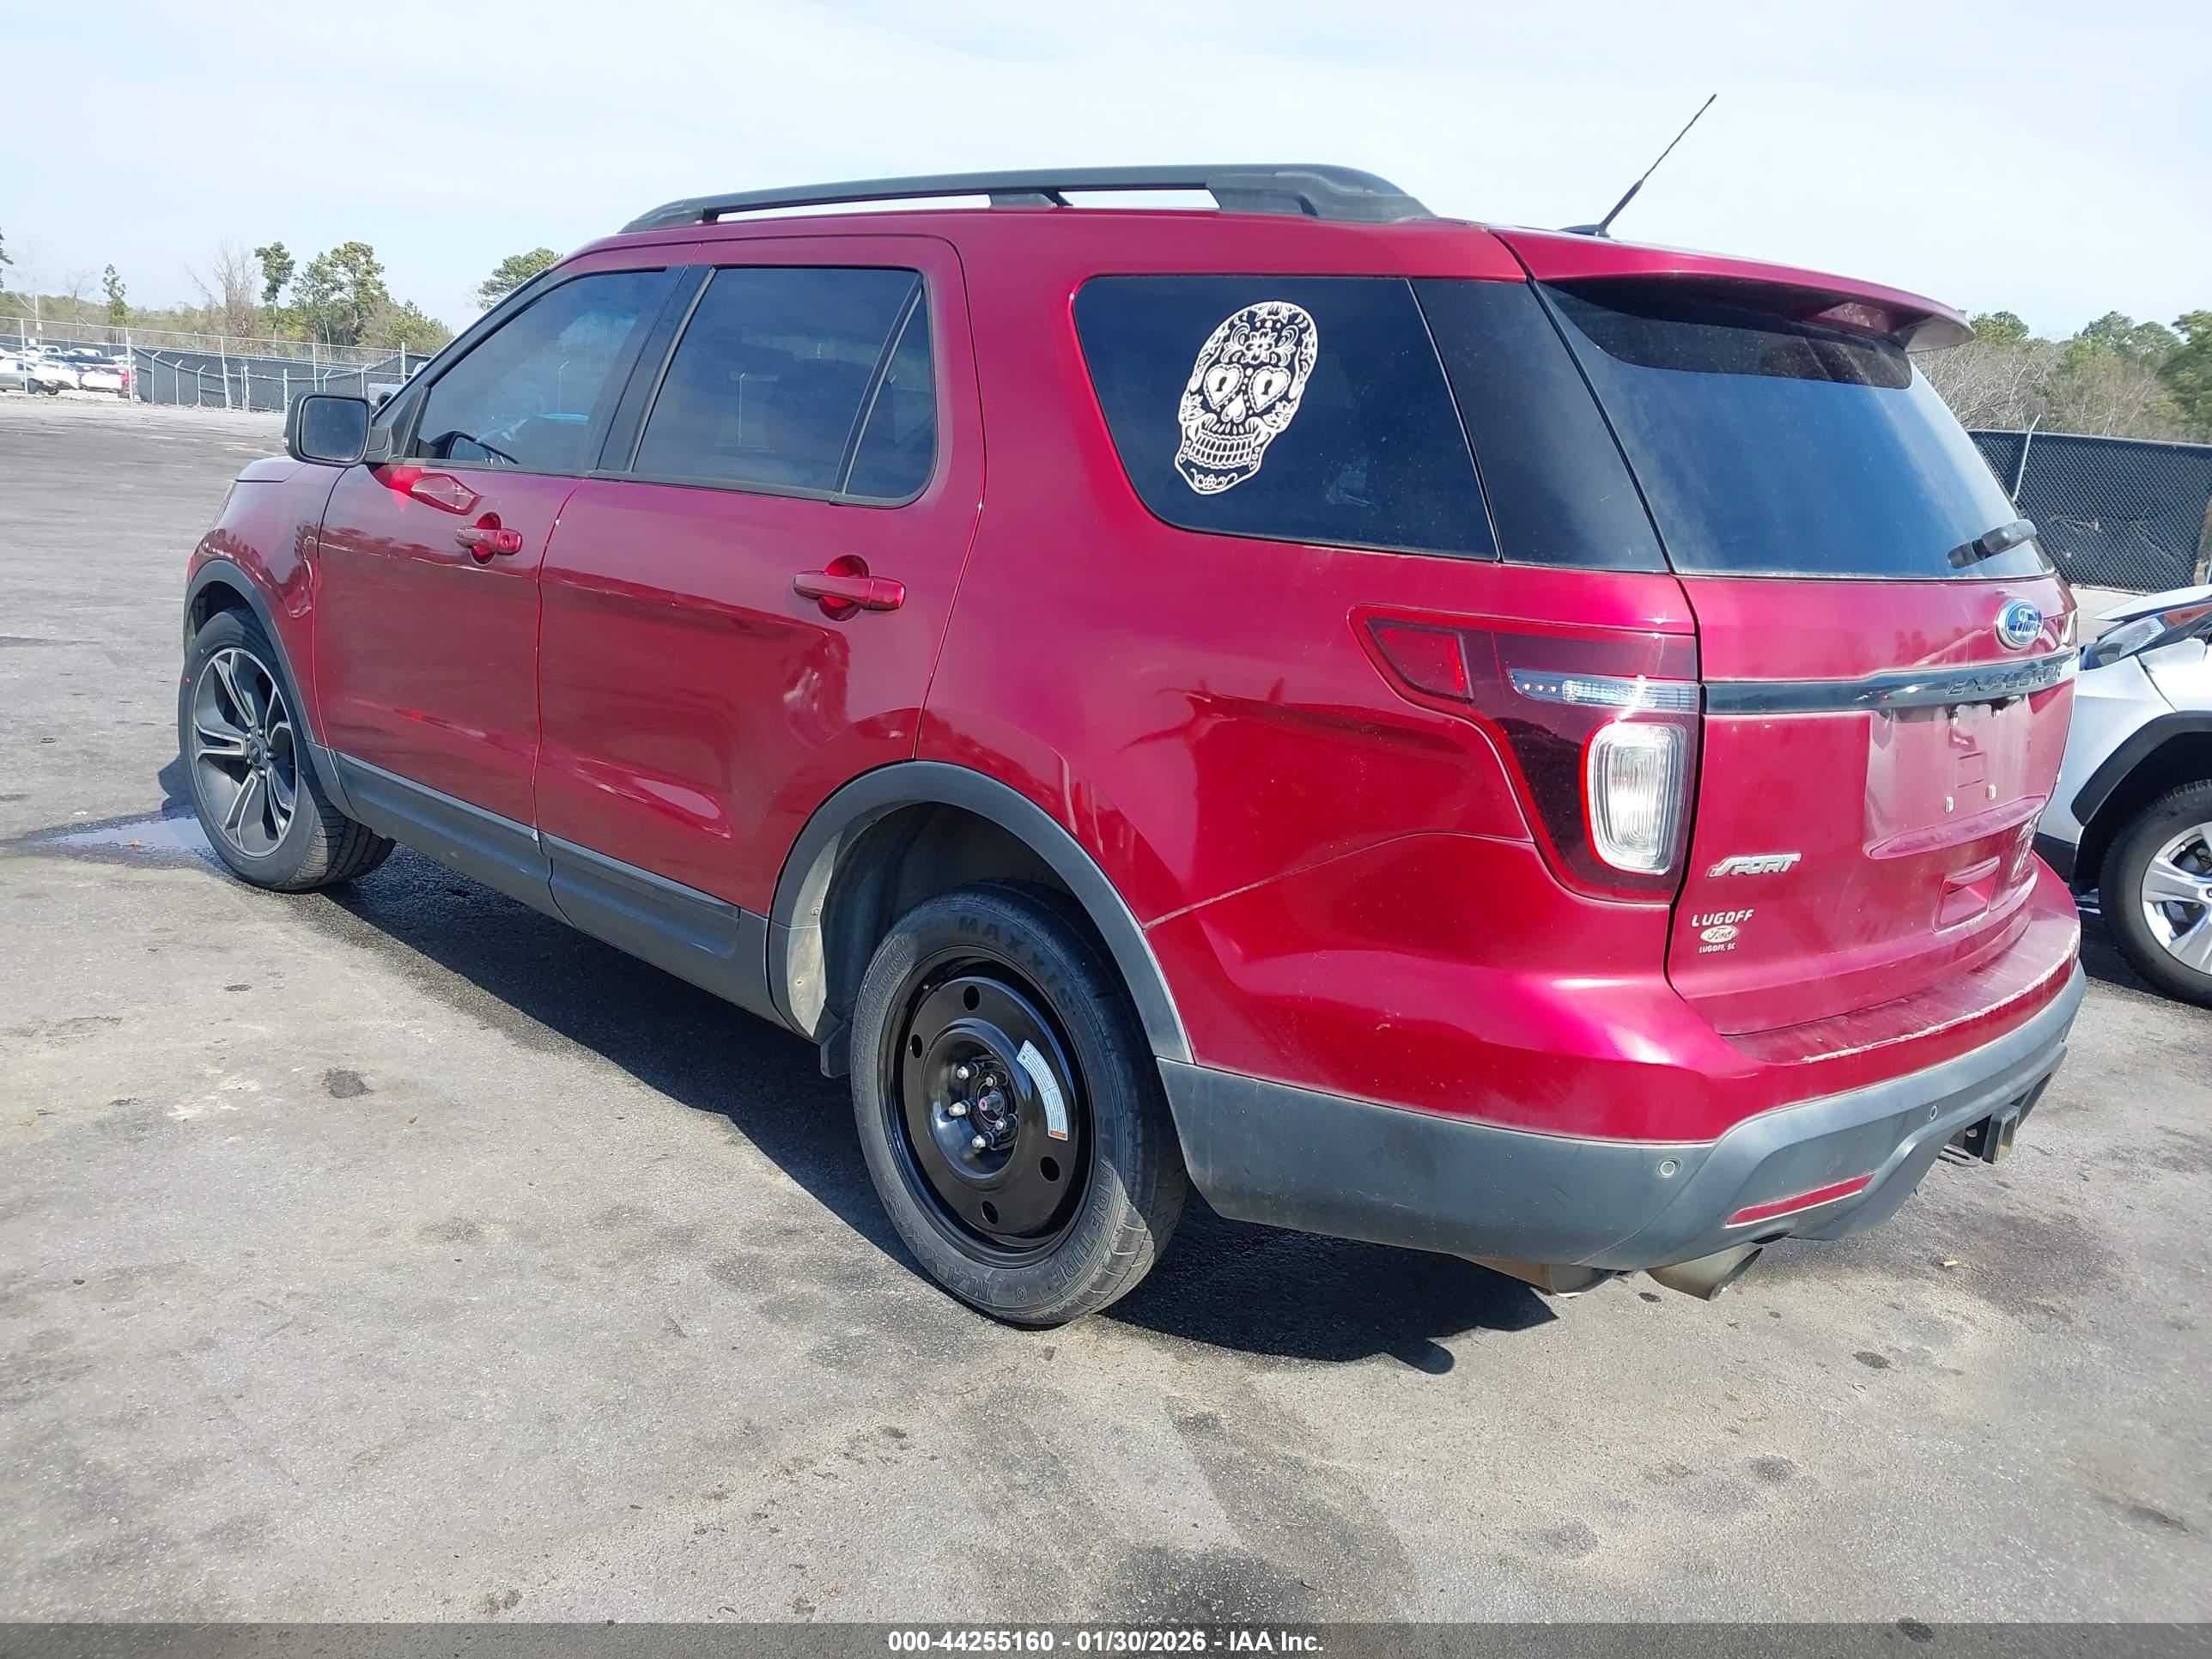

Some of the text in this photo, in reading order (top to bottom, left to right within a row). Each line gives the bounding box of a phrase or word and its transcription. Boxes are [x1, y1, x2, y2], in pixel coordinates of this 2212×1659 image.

[1708, 853, 1802, 878] SPORT
[1691, 908, 1754, 927] LUGOFF
[1705, 927, 1735, 941] Ford
[1727, 943, 1736, 951] SC
[957, 915, 1073, 1011] MAXXIS
[884, 1194, 994, 1303] MAXXIS
[1051, 1232, 1097, 1289] TIRE
